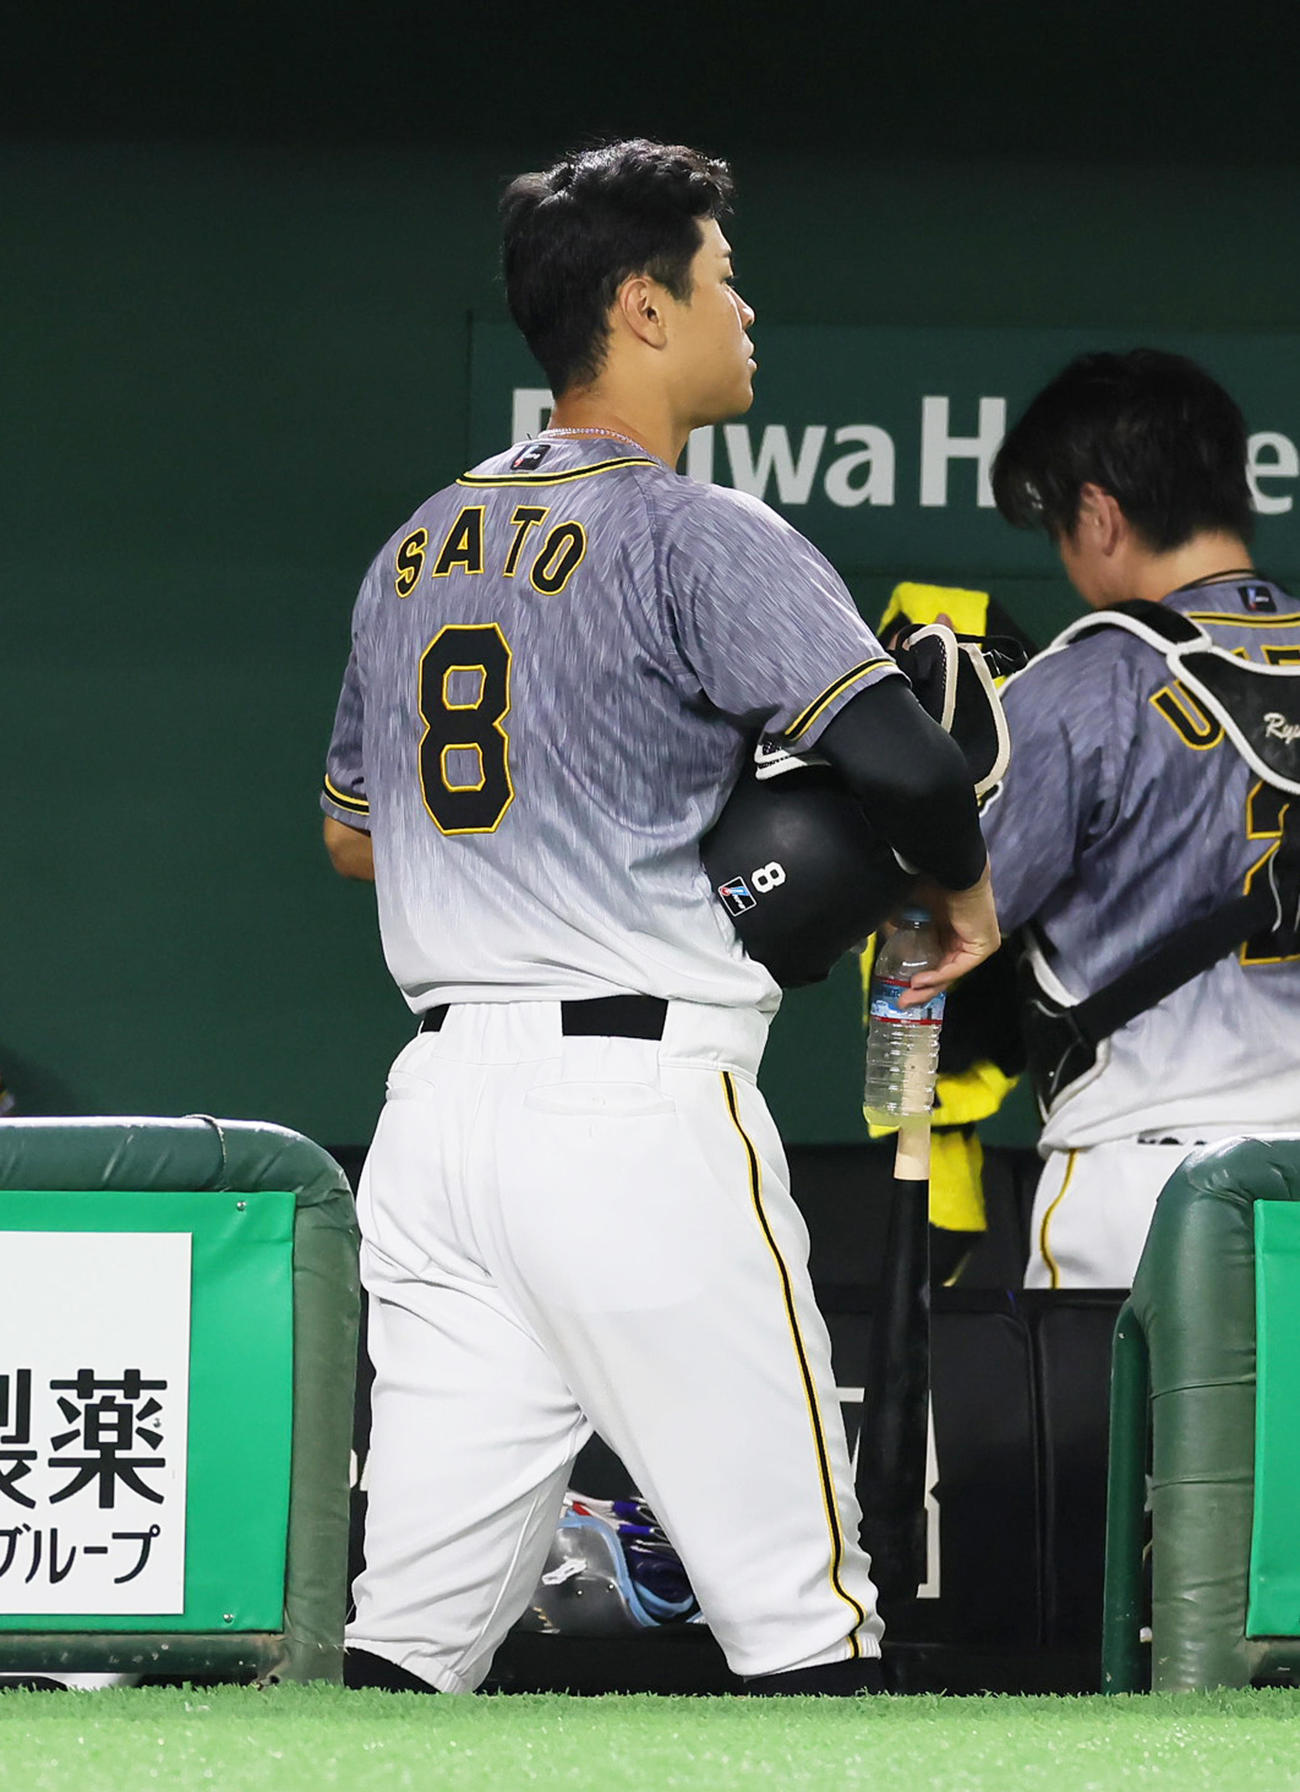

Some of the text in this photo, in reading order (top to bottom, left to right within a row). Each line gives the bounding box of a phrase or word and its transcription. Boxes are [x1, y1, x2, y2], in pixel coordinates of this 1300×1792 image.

[395, 505, 588, 598] SATO
[418, 622, 515, 836] 8
[751, 861, 787, 893] 8
